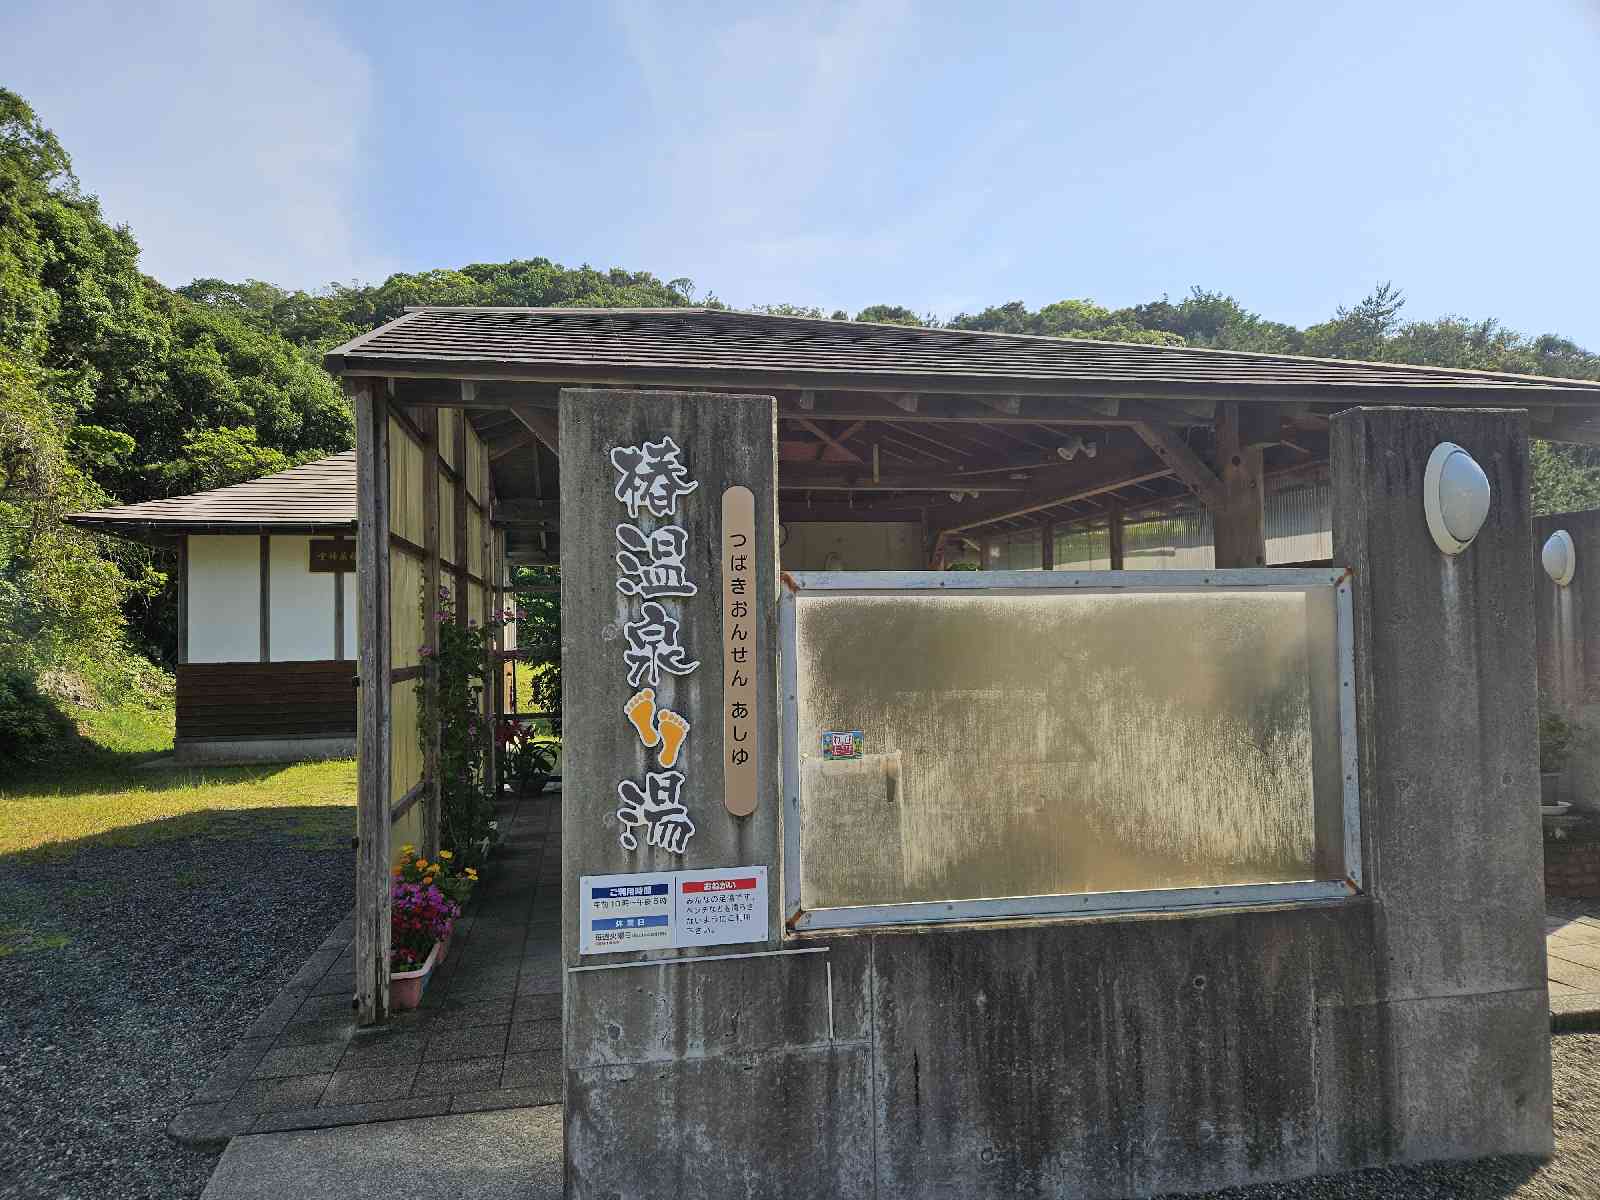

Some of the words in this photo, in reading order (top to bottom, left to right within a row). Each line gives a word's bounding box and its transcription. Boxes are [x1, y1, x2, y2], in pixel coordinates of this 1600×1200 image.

[611, 436, 699, 686] 椿温泉
[730, 532, 749, 688] つばきおんせん
[730, 701, 749, 767] あしゆ
[617, 771, 695, 854] 湯
